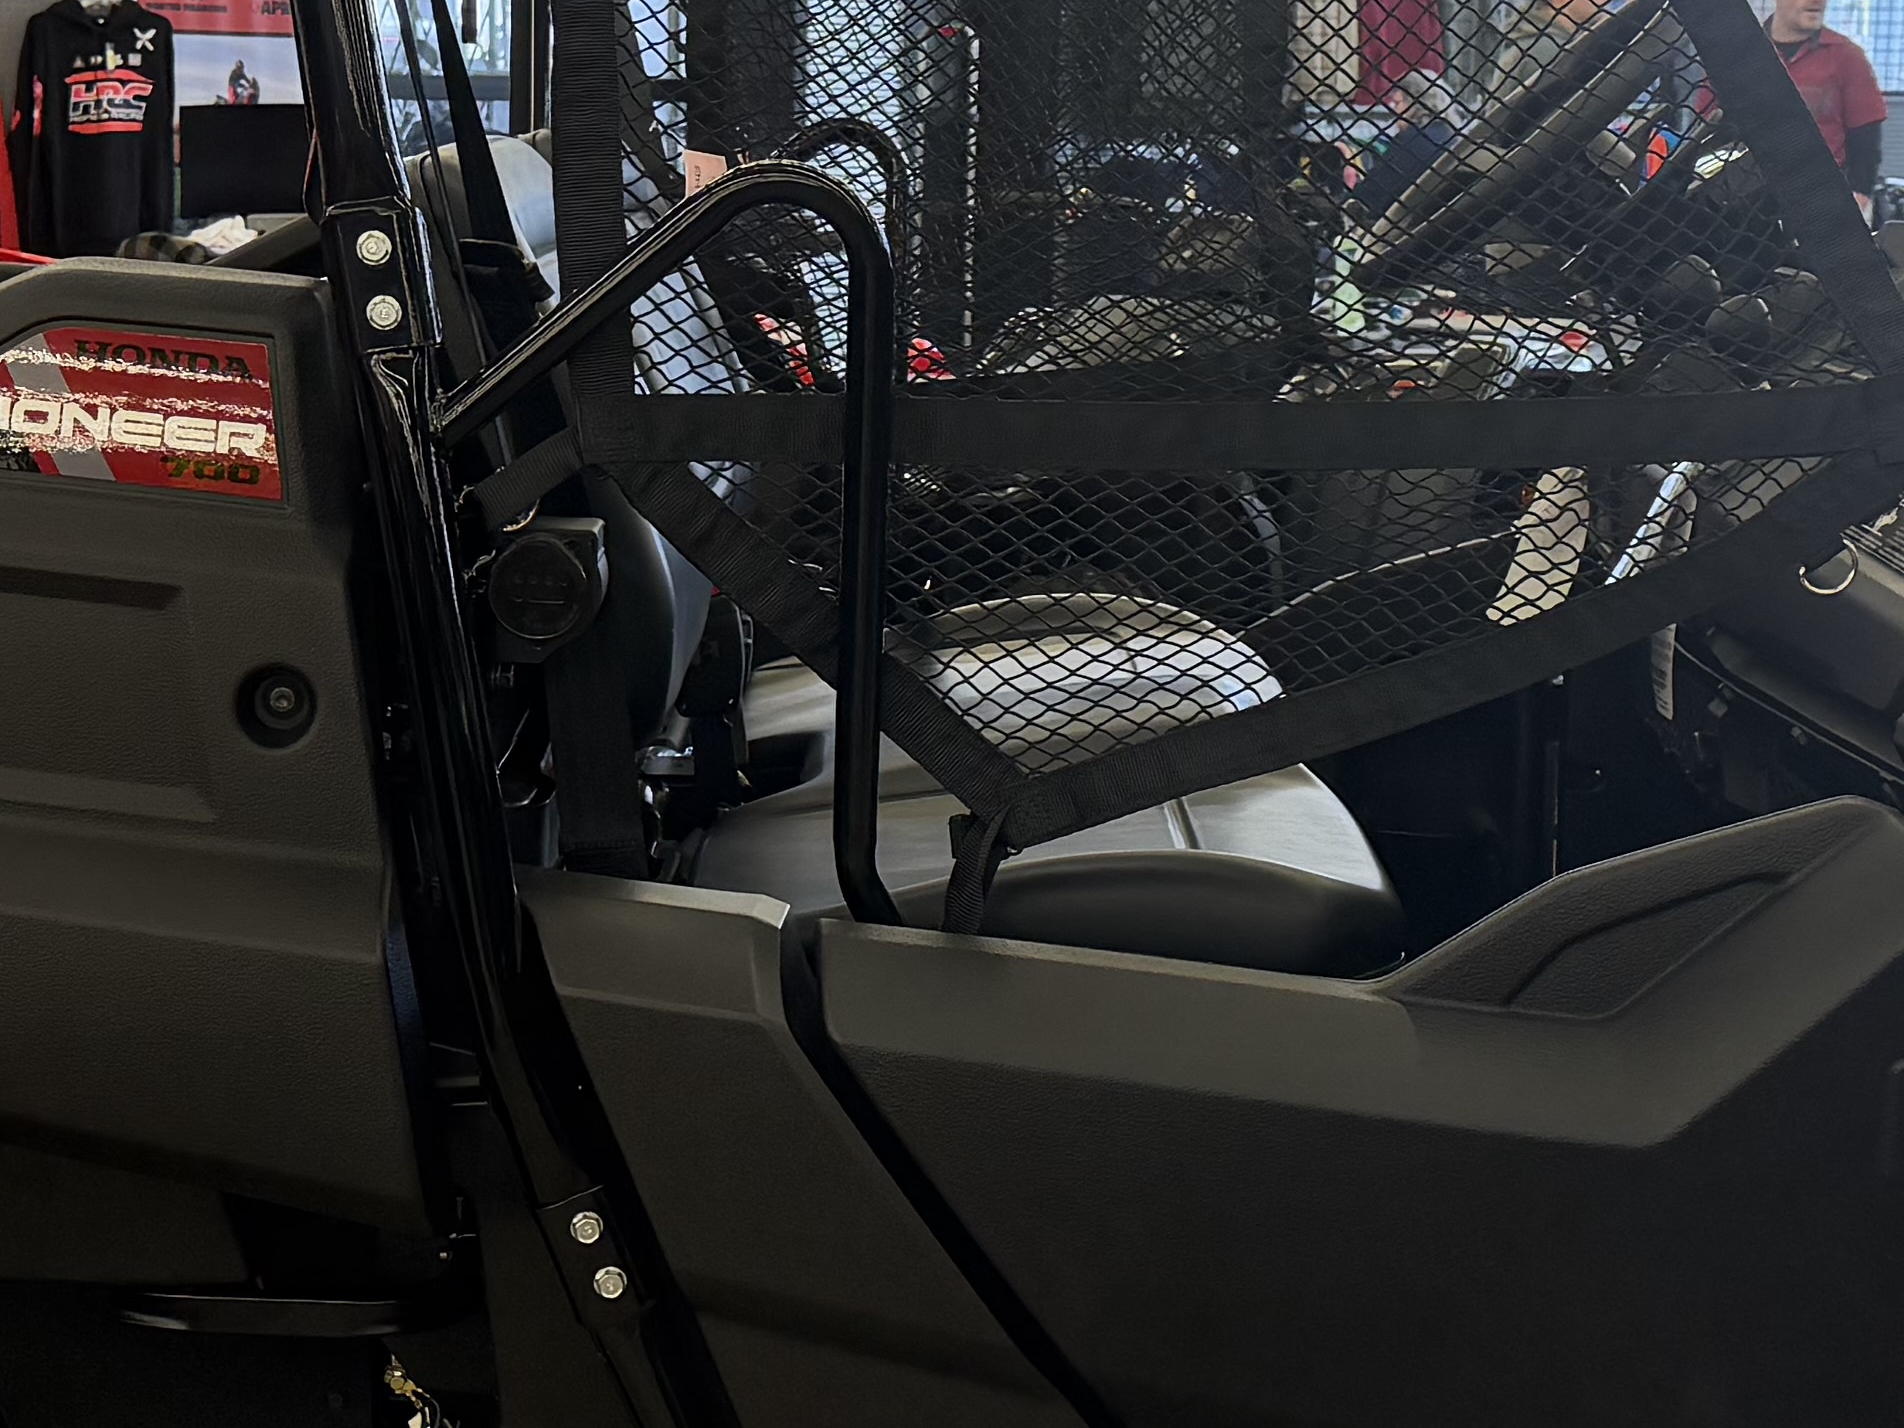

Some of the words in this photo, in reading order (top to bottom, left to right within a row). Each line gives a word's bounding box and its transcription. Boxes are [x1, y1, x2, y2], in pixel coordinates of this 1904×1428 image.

[69, 81, 153, 118] HRC
[73, 339, 254, 380] HONDA
[159, 454, 259, 485] 700
